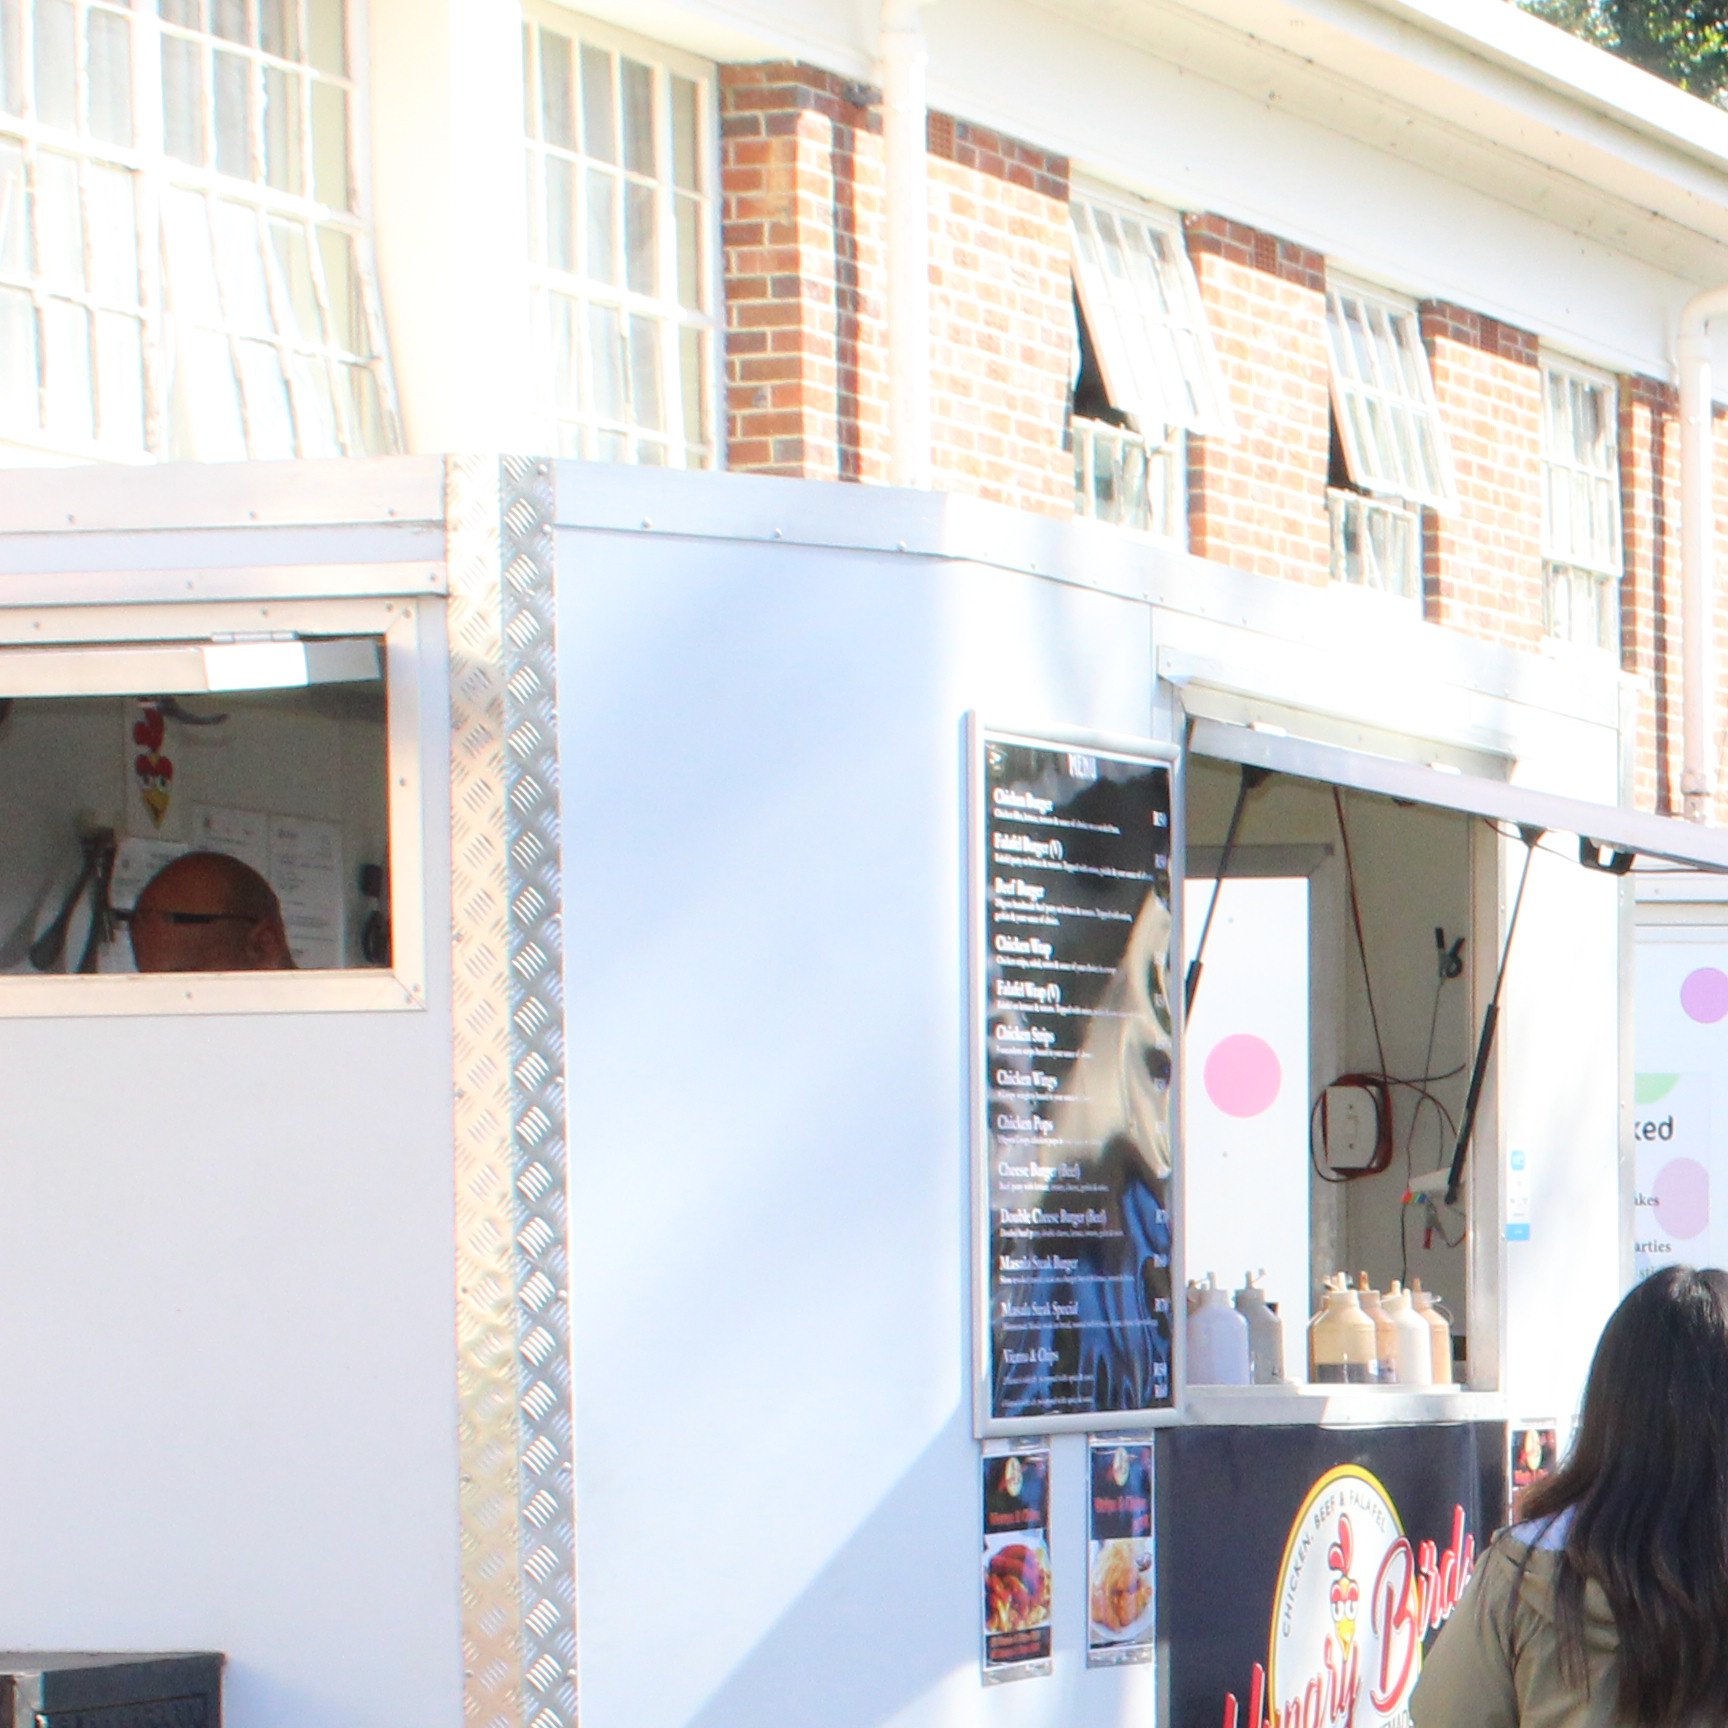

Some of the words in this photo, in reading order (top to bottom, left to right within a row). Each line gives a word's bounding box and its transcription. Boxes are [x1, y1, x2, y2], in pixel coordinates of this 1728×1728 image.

[994, 787, 1025, 808] Chicken
[995, 934, 1030, 955] Chicken
[996, 979, 1024, 999] Falafel
[996, 1023, 1031, 1042] Chicken
[997, 1069, 1032, 1088] Chicken
[1032, 1071, 1058, 1092] Wings
[997, 1114, 1032, 1132] Chicken
[1033, 1116, 1055, 1136] Pops
[999, 1161, 1030, 1179] Cheese
[1030, 1162, 1057, 1183] Burger
[1000, 1208, 1031, 1225] Double
[1032, 1208, 1059, 1225] Cheese
[1060, 1208, 1085, 1229] Burger
[1281, 1531, 1315, 1638] CHICKEN,
[1314, 1496, 1336, 1530] BEEF
[1349, 1490, 1387, 1533] FALAFEL
